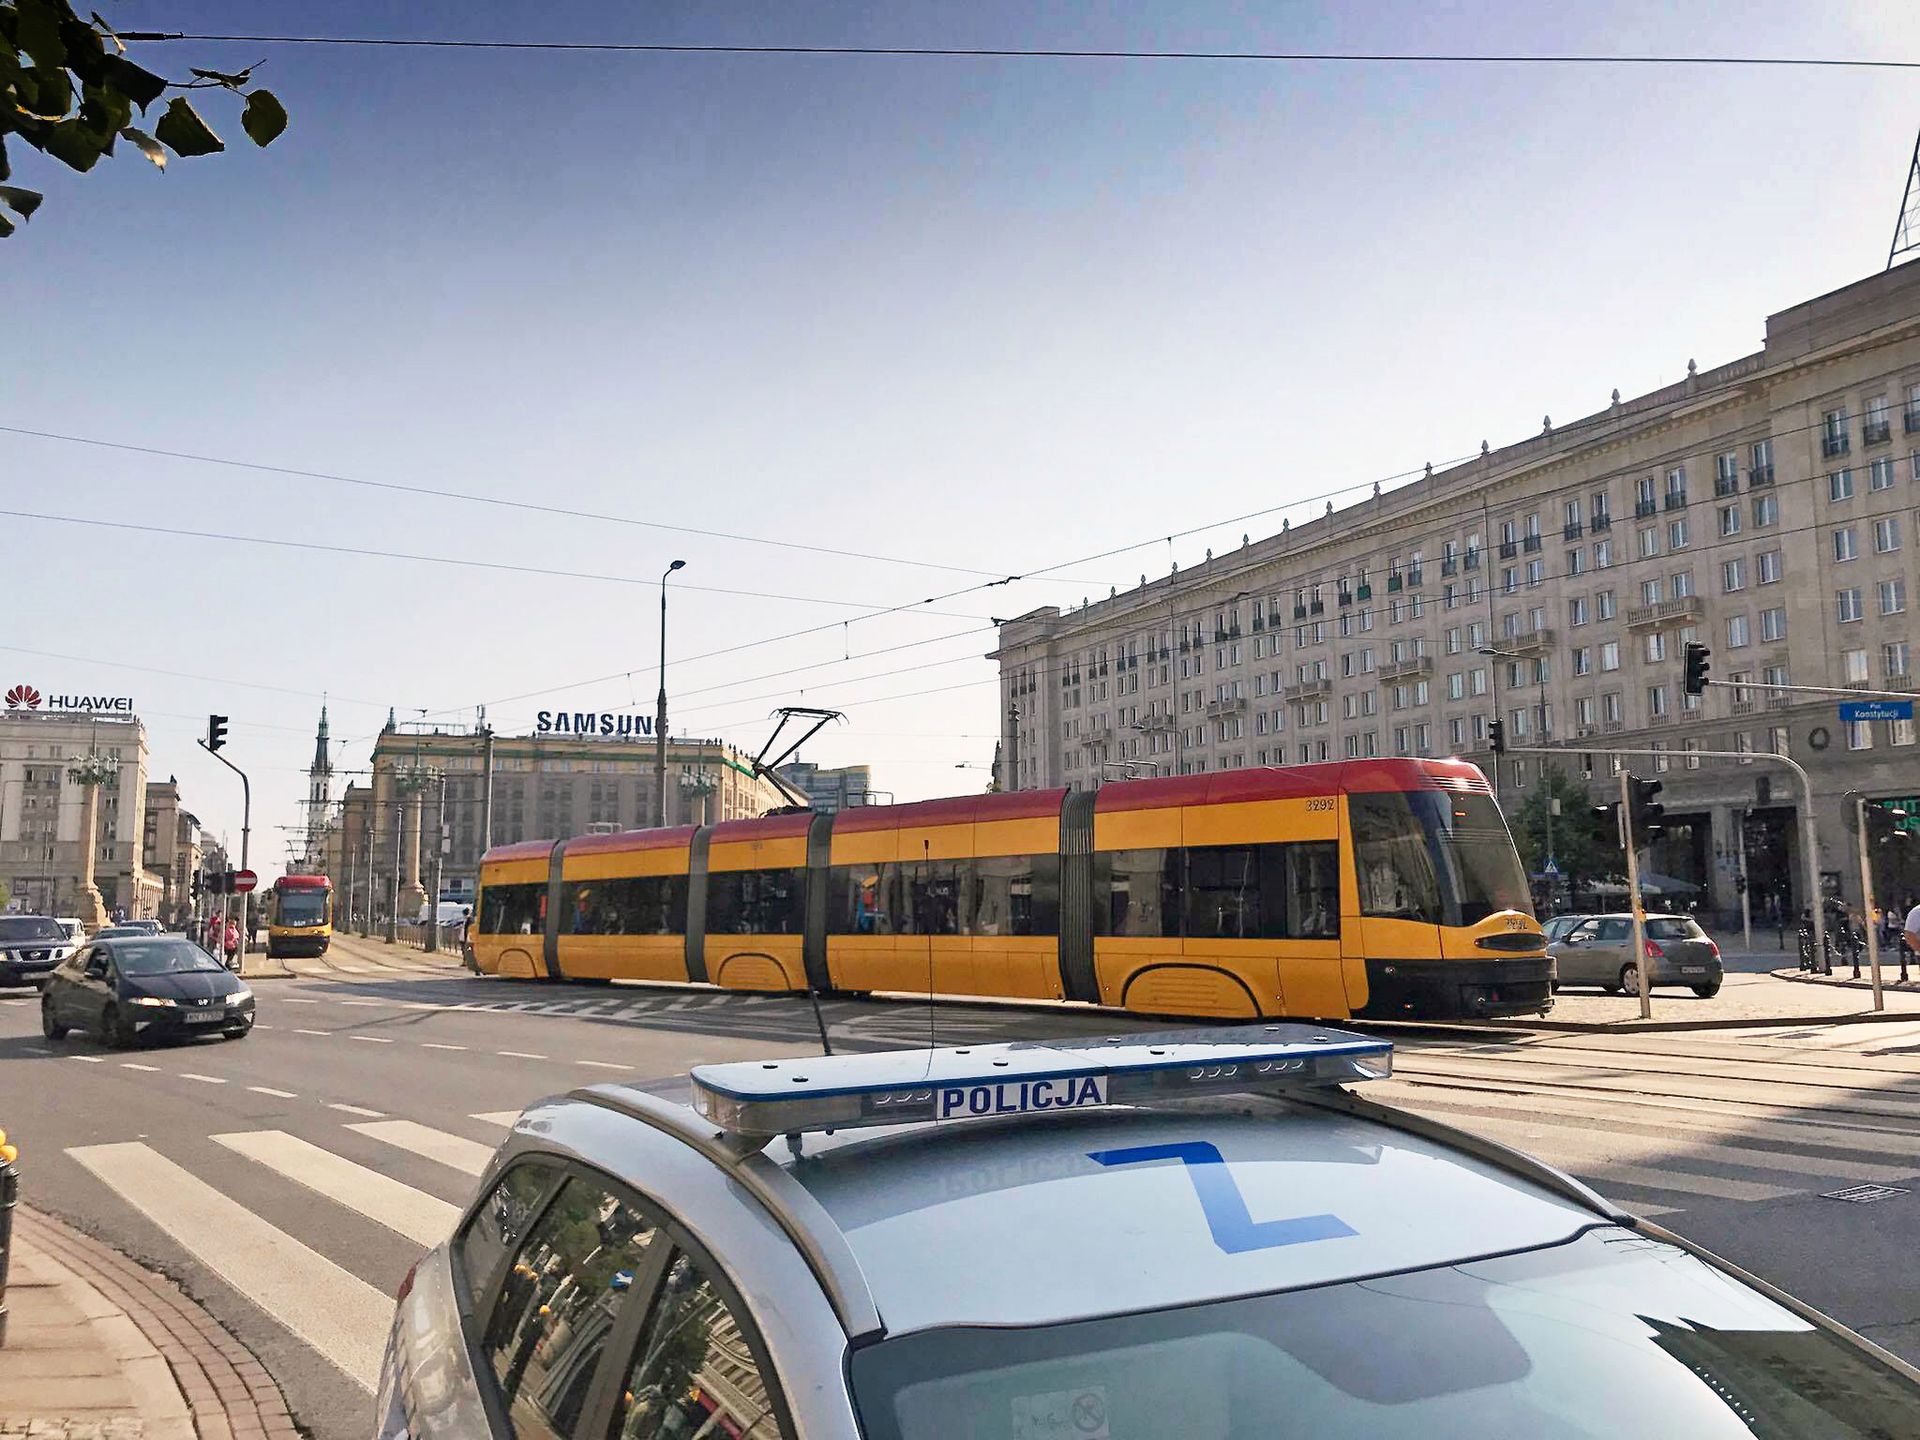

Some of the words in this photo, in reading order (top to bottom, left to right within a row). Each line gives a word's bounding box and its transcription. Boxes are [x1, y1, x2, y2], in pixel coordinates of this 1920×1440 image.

[48, 694, 133, 711] HUAWEI
[1305, 799, 1335, 811] 3292
[942, 1077, 1103, 1118] POLICJA
